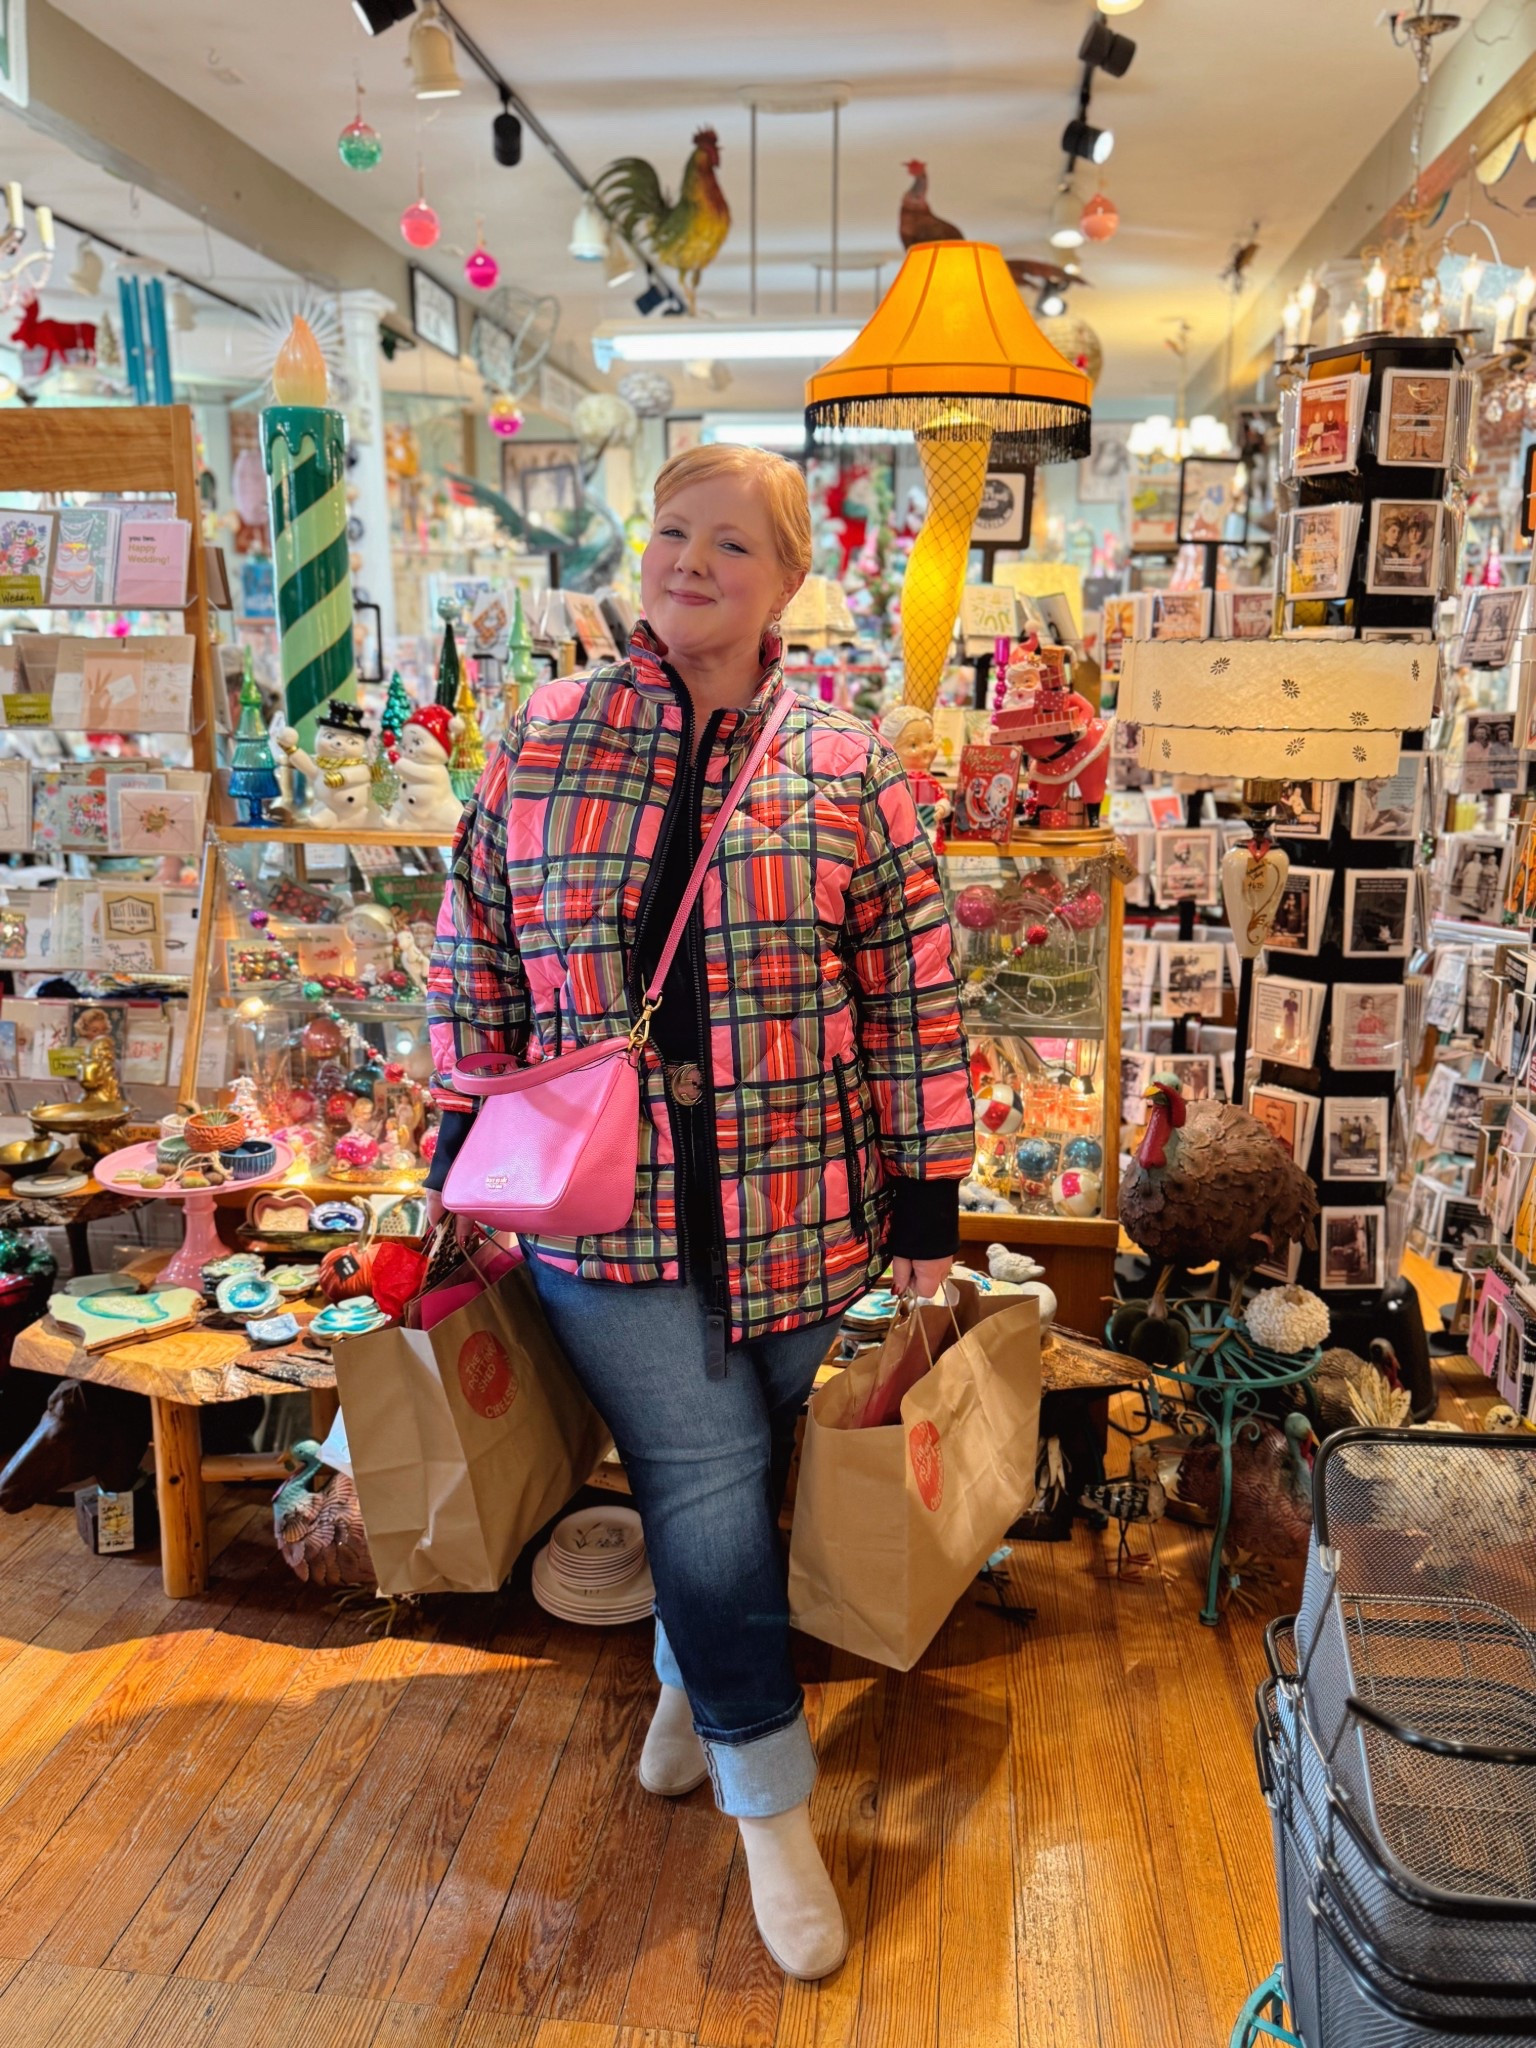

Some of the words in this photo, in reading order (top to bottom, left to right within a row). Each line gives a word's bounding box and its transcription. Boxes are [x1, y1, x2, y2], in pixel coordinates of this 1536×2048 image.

[128, 544, 157, 554] Happy
[128, 555, 170, 566] Wedding!
[466, 1352, 481, 1375] THE
[468, 1341, 498, 1391] POTTING
[479, 1363, 496, 1393] SHED
